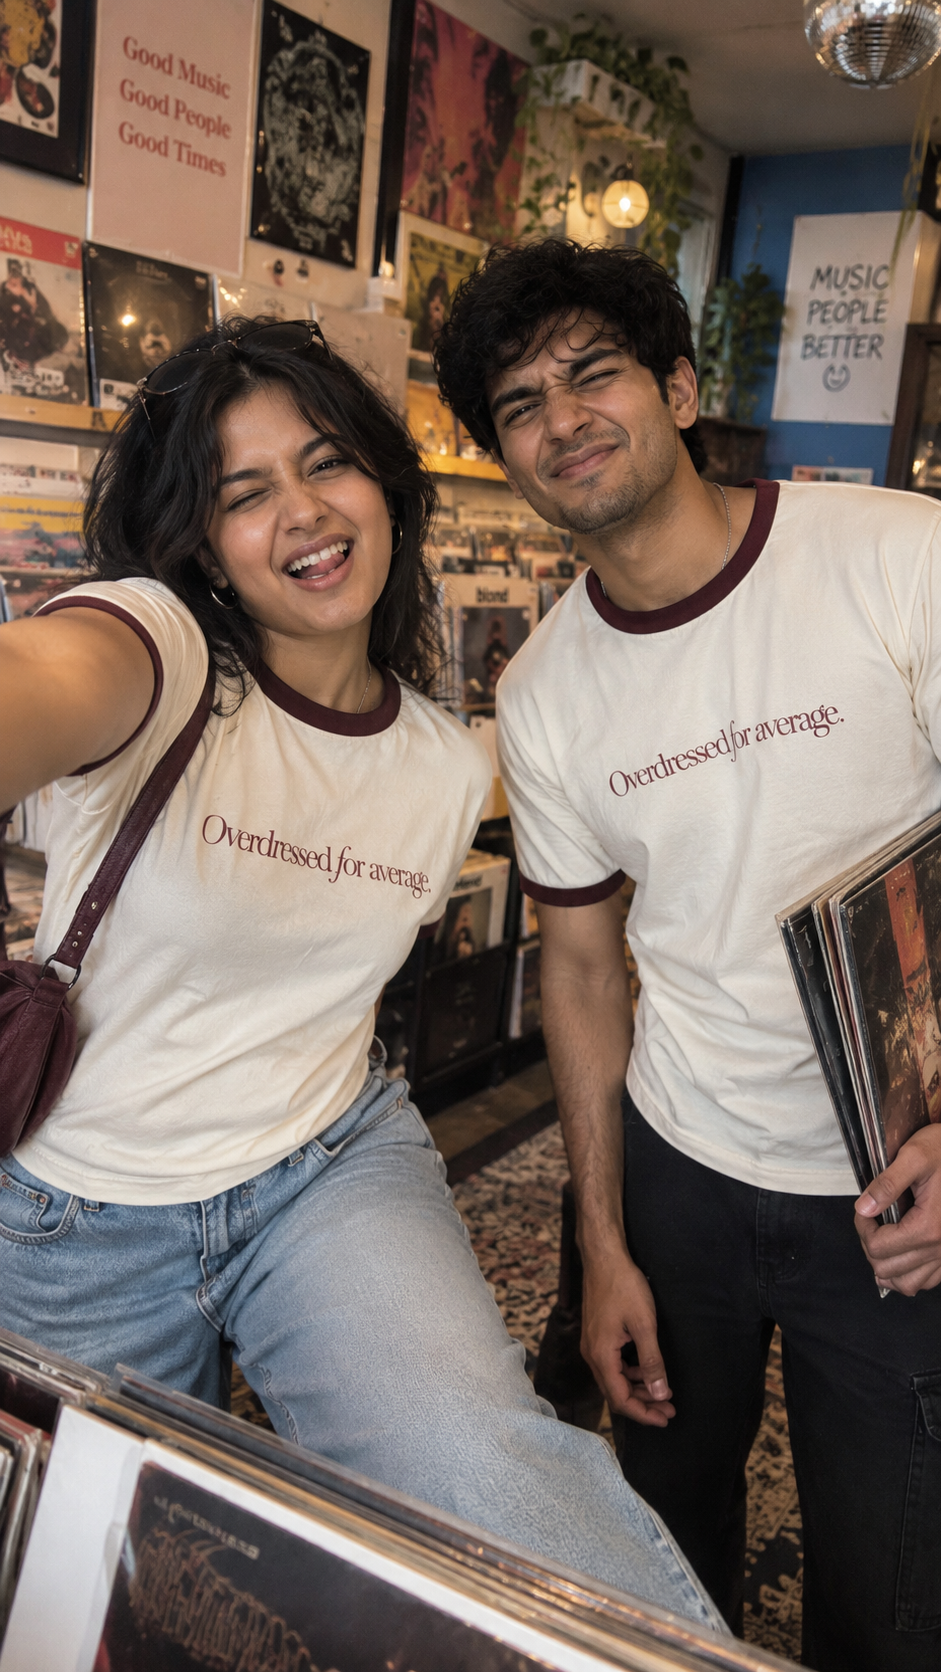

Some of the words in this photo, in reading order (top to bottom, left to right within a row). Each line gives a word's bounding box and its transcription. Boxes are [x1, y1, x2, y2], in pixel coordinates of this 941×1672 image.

[123, 35, 173, 76] Good
[177, 57, 231, 100] Music
[119, 78, 169, 117] Good
[174, 98, 232, 140] People
[118, 120, 169, 158] Good
[172, 138, 226, 177] Times
[809, 263, 890, 291] MUSIC
[806, 298, 889, 325] PEOPLE
[801, 333, 885, 361] BETTER
[608, 728, 731, 797] Overdressed
[729, 719, 751, 763] for
[755, 704, 845, 738] average.
[201, 814, 333, 872] Overdressed
[328, 845, 366, 884] for
[369, 862, 432, 899] average.
